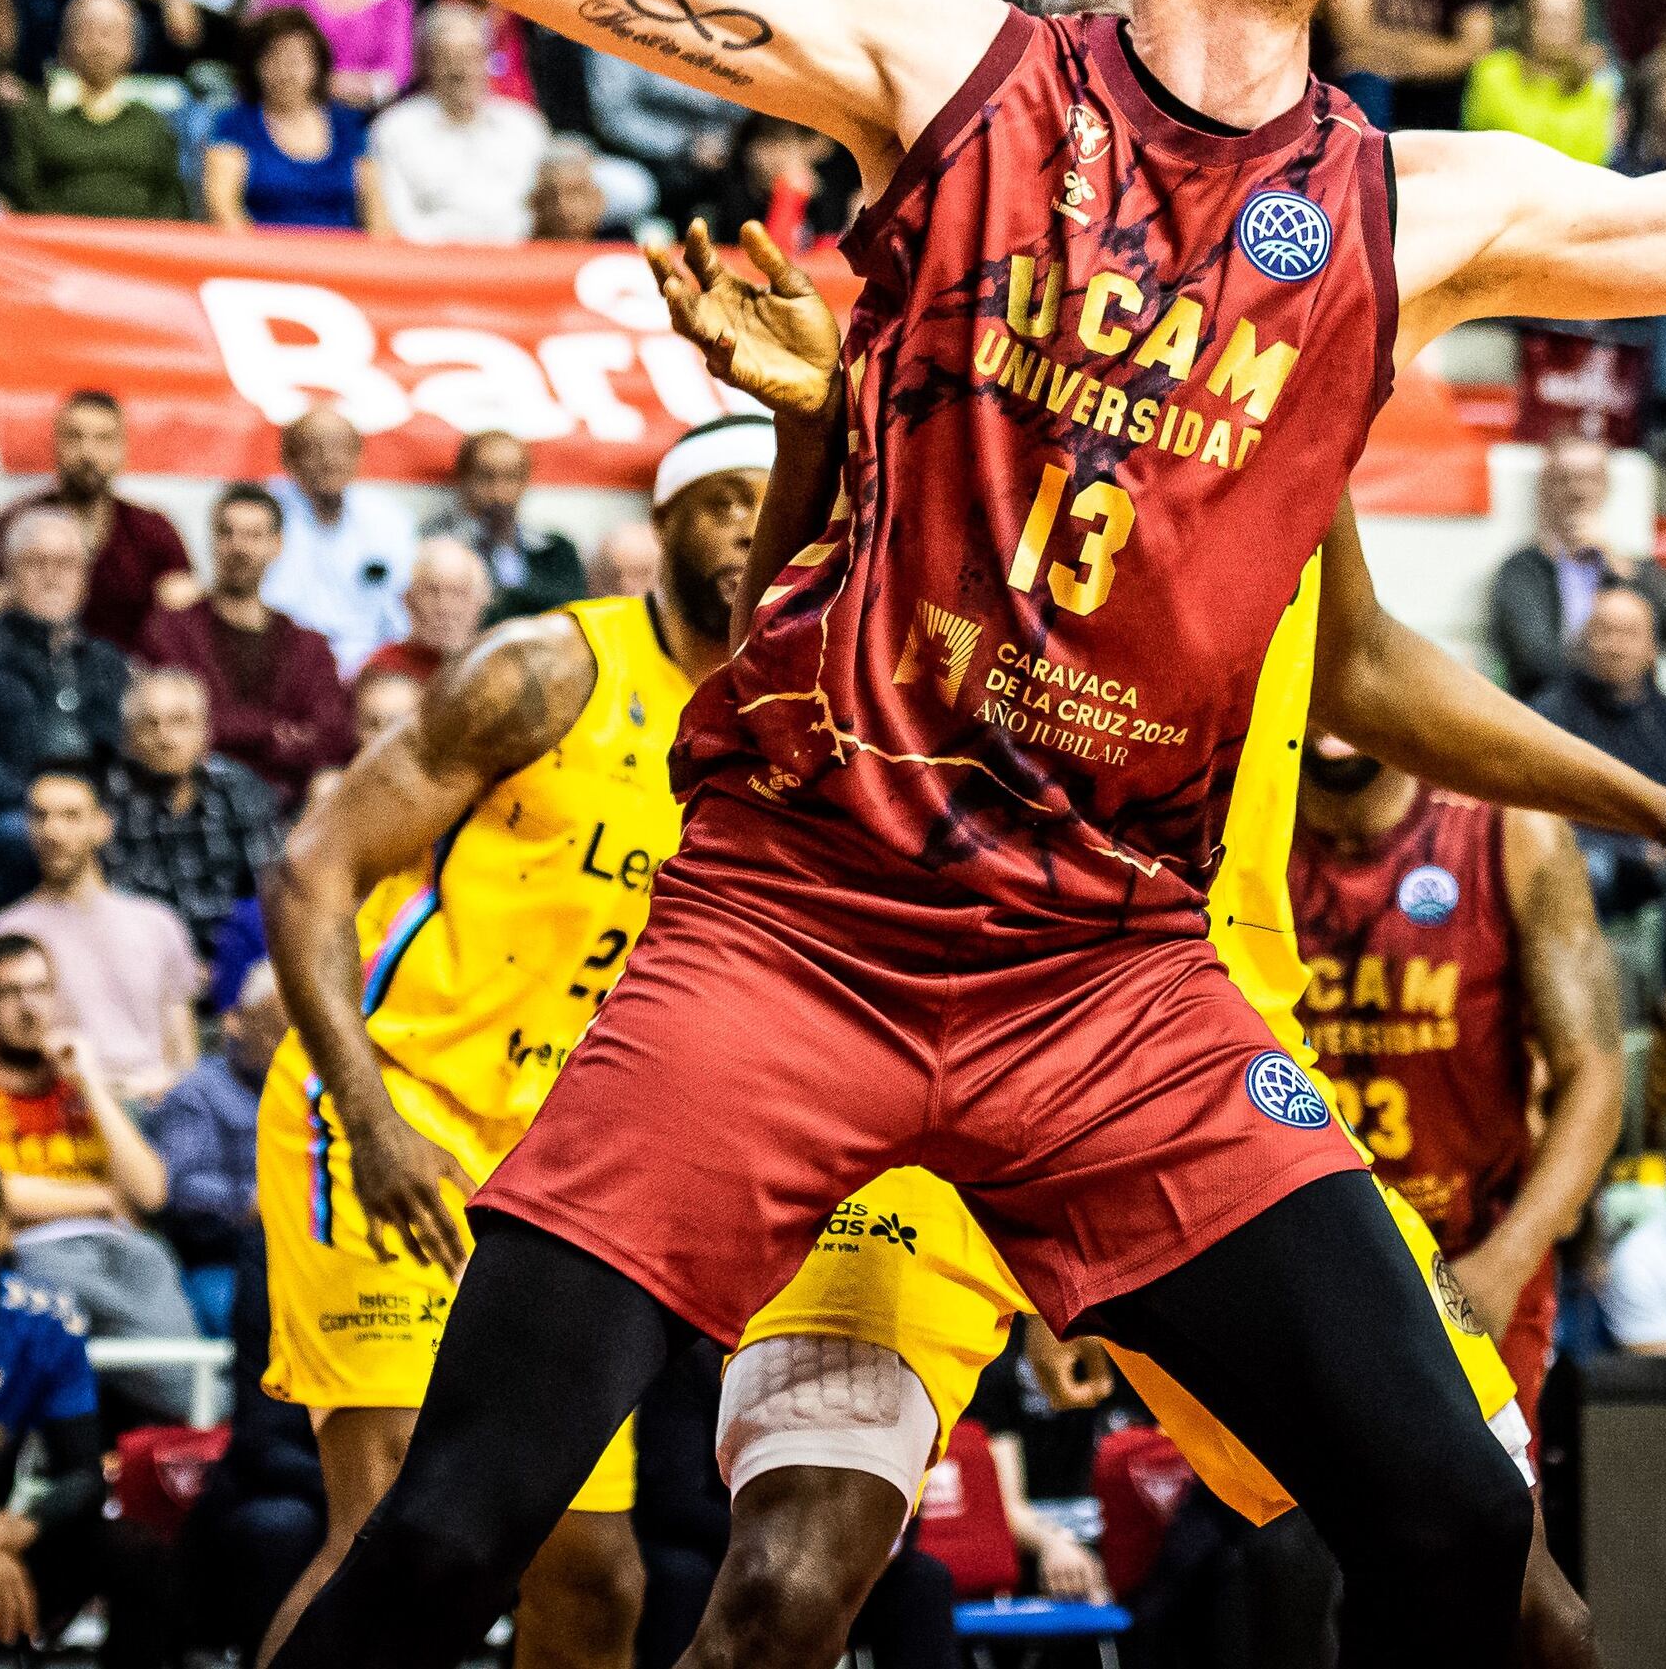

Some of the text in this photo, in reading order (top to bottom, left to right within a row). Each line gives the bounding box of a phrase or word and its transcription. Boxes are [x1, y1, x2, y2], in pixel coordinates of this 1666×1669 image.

[1006, 254, 1301, 424] UCAM
[1007, 462, 1137, 617] 13
[985, 668, 1190, 747] DE LA CRUZ 2024
[996, 642, 1139, 710] CARAVACA
[973, 698, 1130, 767] AÑO JUBILAR
[582, 821, 653, 894] Le
[1303, 954, 1462, 1017] CAM
